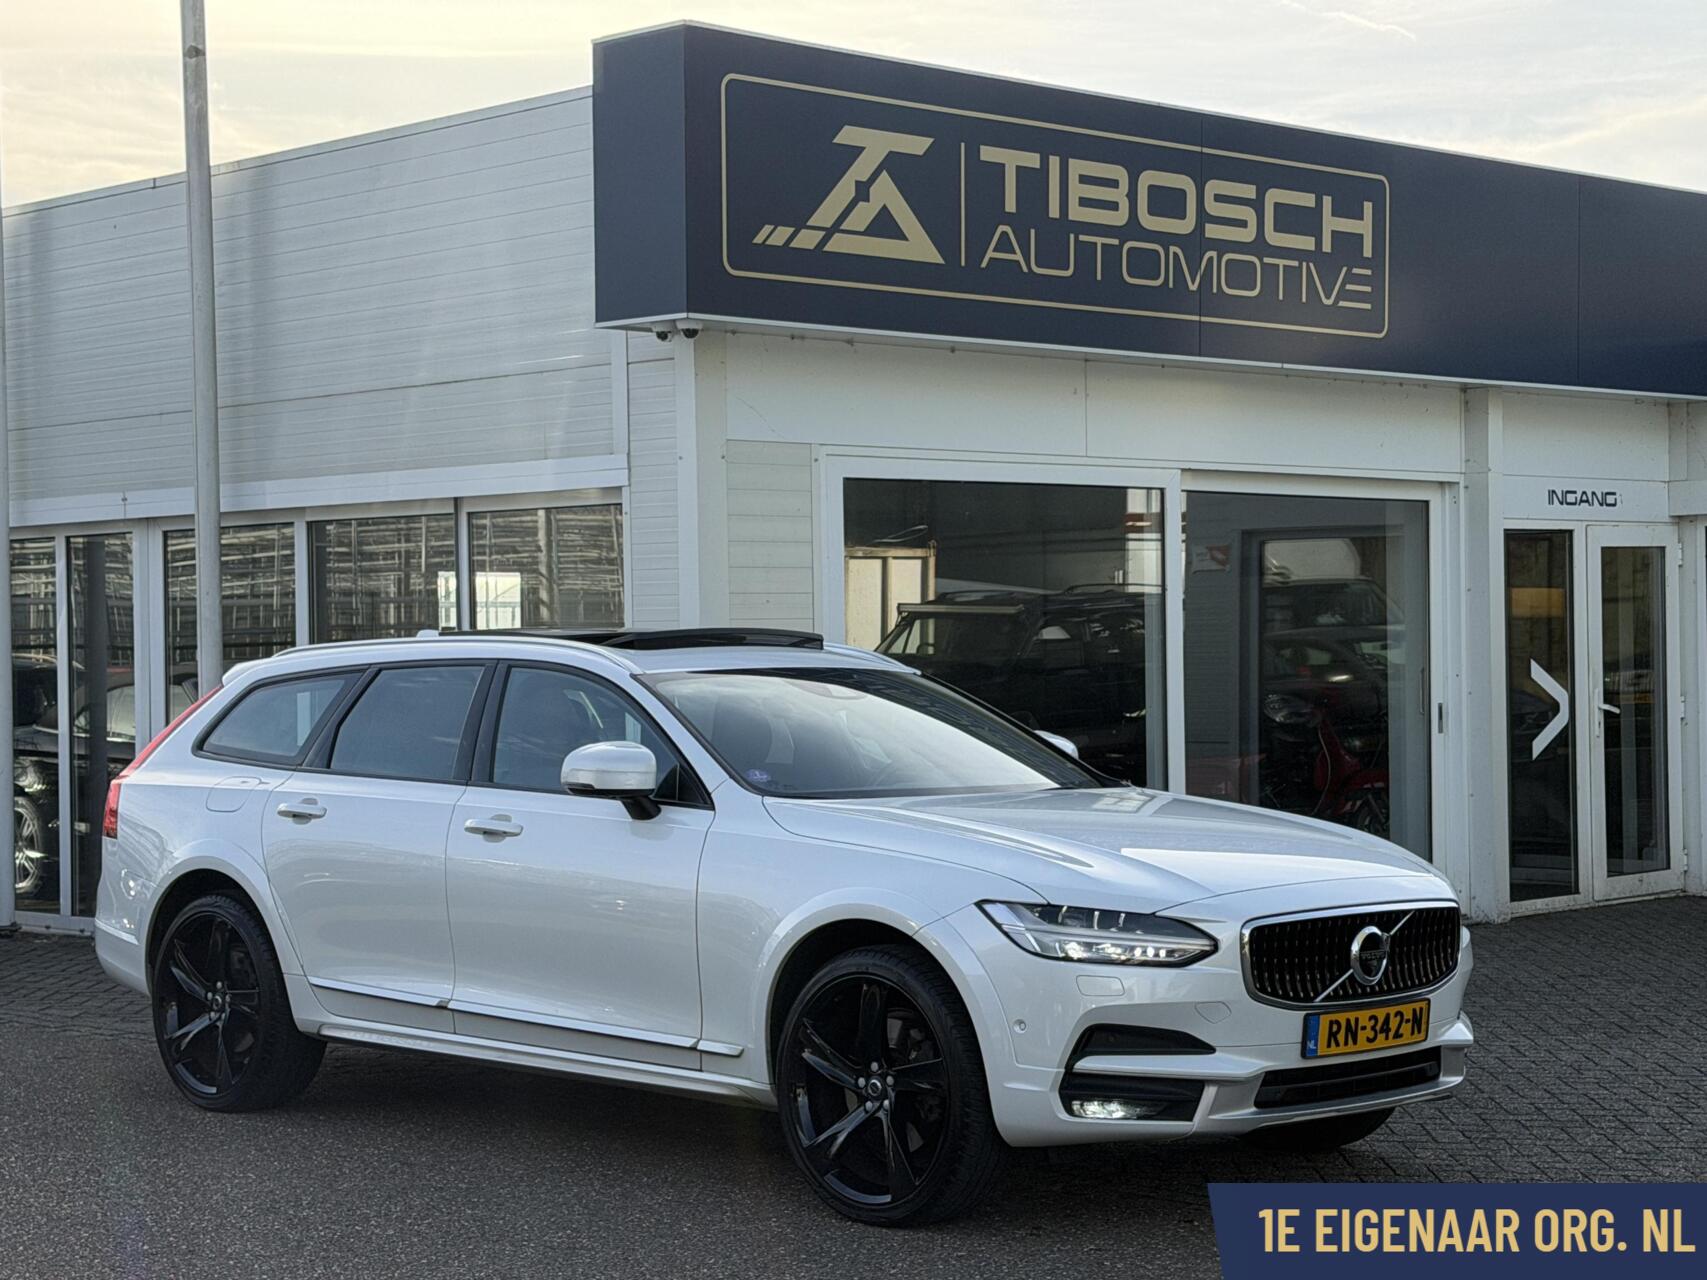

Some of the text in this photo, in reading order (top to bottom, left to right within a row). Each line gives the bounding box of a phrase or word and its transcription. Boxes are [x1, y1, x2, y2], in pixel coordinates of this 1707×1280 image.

[979, 145, 1373, 258] TIBOSCH
[978, 224, 1373, 310] AUTOMOTIVE
[1547, 489, 1617, 507] INGANG
[1326, 1006, 1424, 1049] RN-342-N
